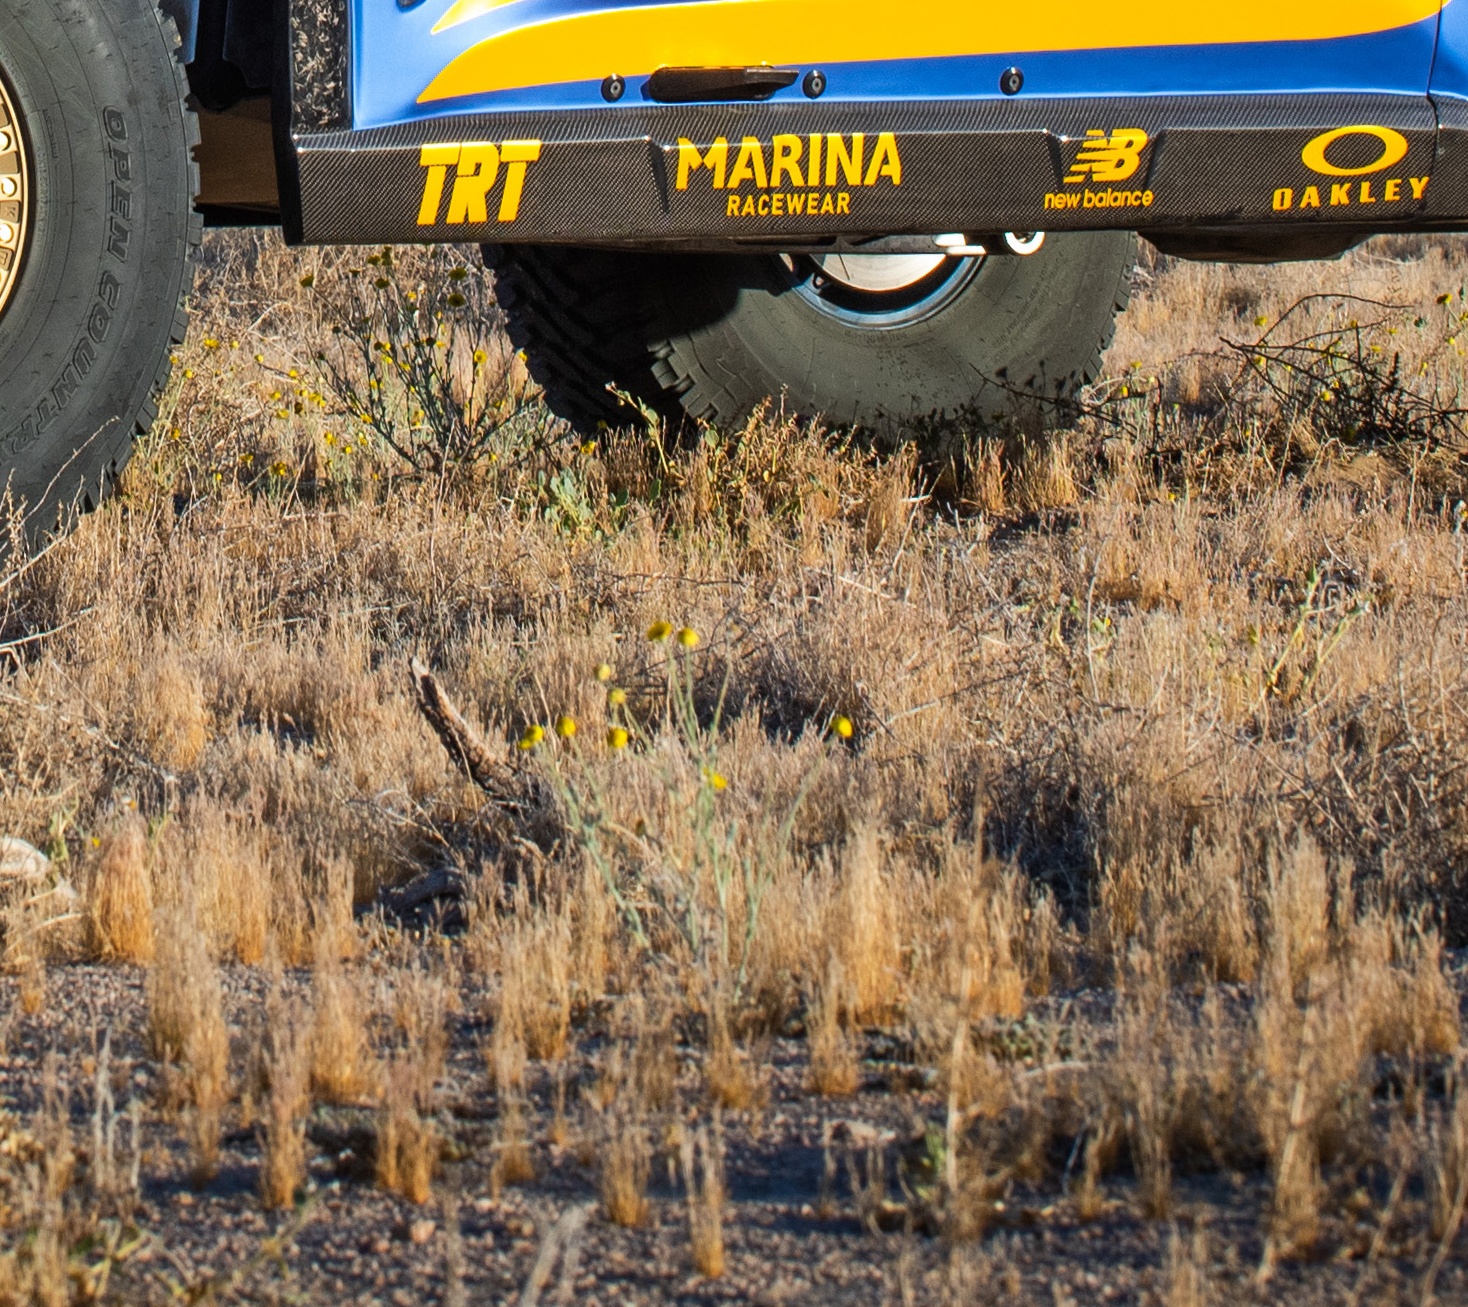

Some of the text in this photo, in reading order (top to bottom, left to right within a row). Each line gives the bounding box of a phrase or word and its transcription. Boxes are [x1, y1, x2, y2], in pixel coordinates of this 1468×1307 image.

[101, 104, 134, 263] OPEN
[416, 139, 542, 226] TRT
[675, 131, 902, 191] MARINA
[725, 191, 851, 217] RACEWEAR
[1044, 188, 1154, 210] new balance
[1272, 176, 1430, 211] OAKLEY
